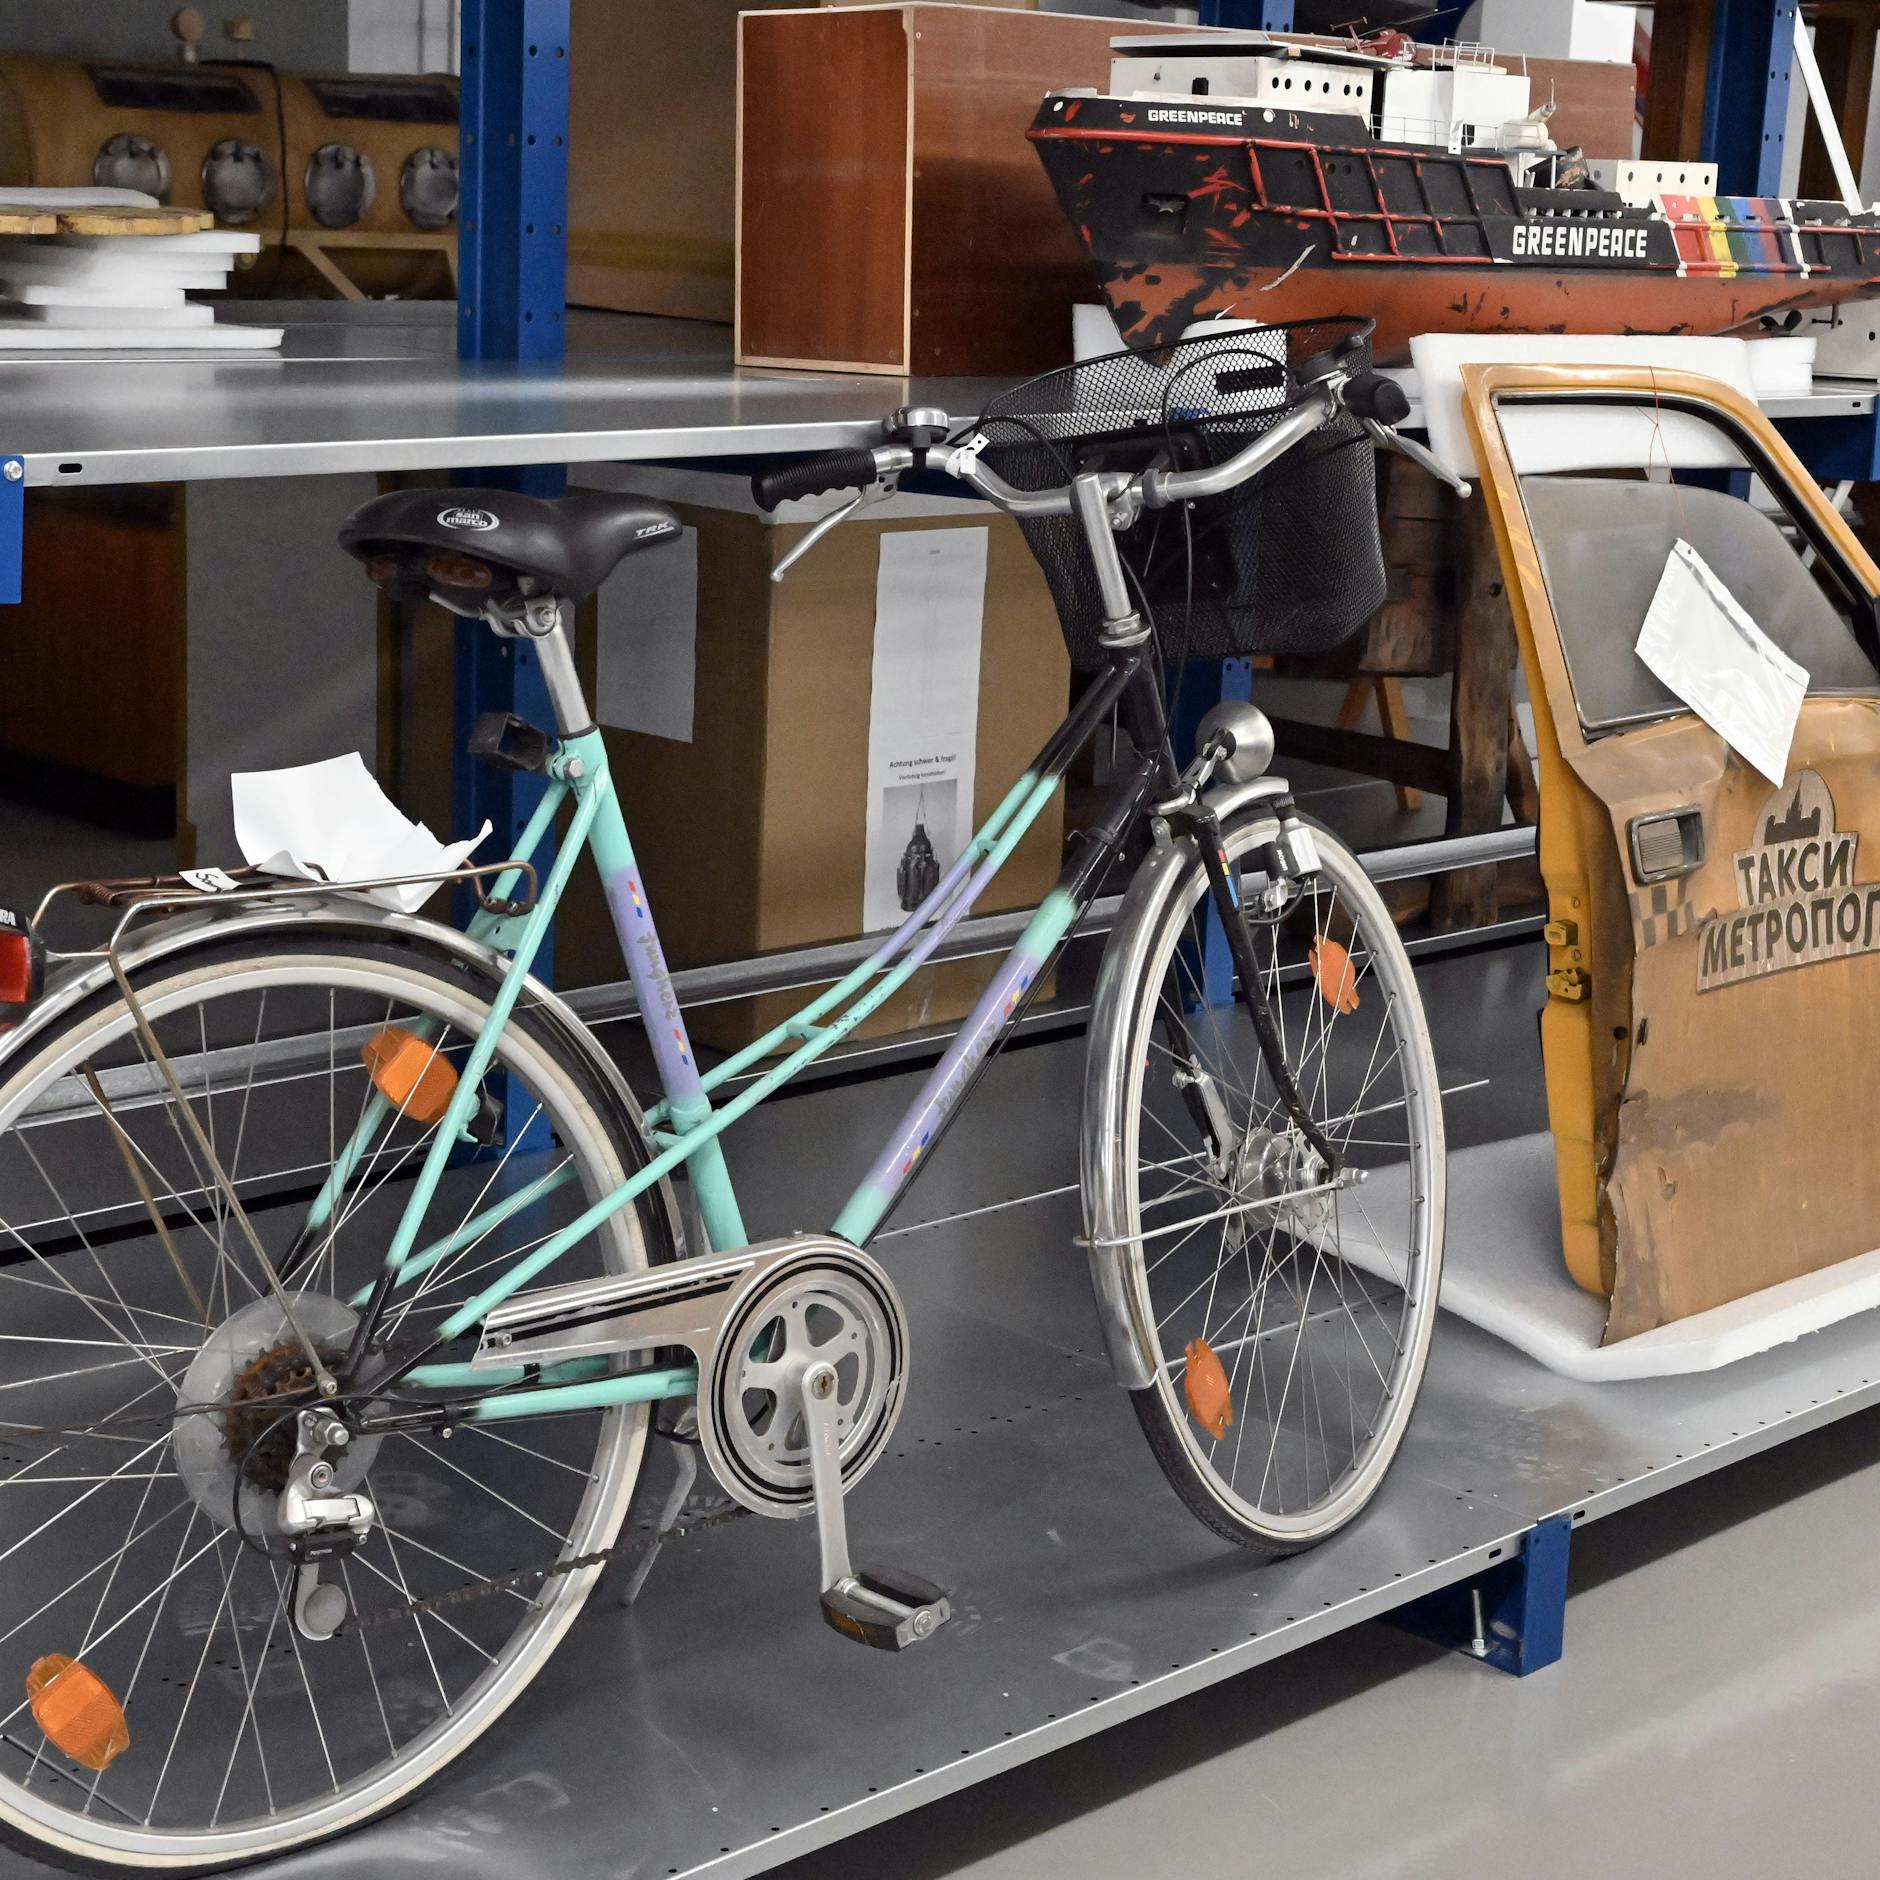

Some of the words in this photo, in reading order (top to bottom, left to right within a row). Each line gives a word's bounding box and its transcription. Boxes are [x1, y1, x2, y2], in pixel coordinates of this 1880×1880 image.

[1147, 109, 1243, 126] GREENPEACE
[1512, 225, 1648, 258] GREENPEACE
[889, 760, 913, 768] Achtung
[914, 757, 934, 766] schwer
[935, 755, 939, 763] &
[1737, 839, 1851, 906] ТАКСИ
